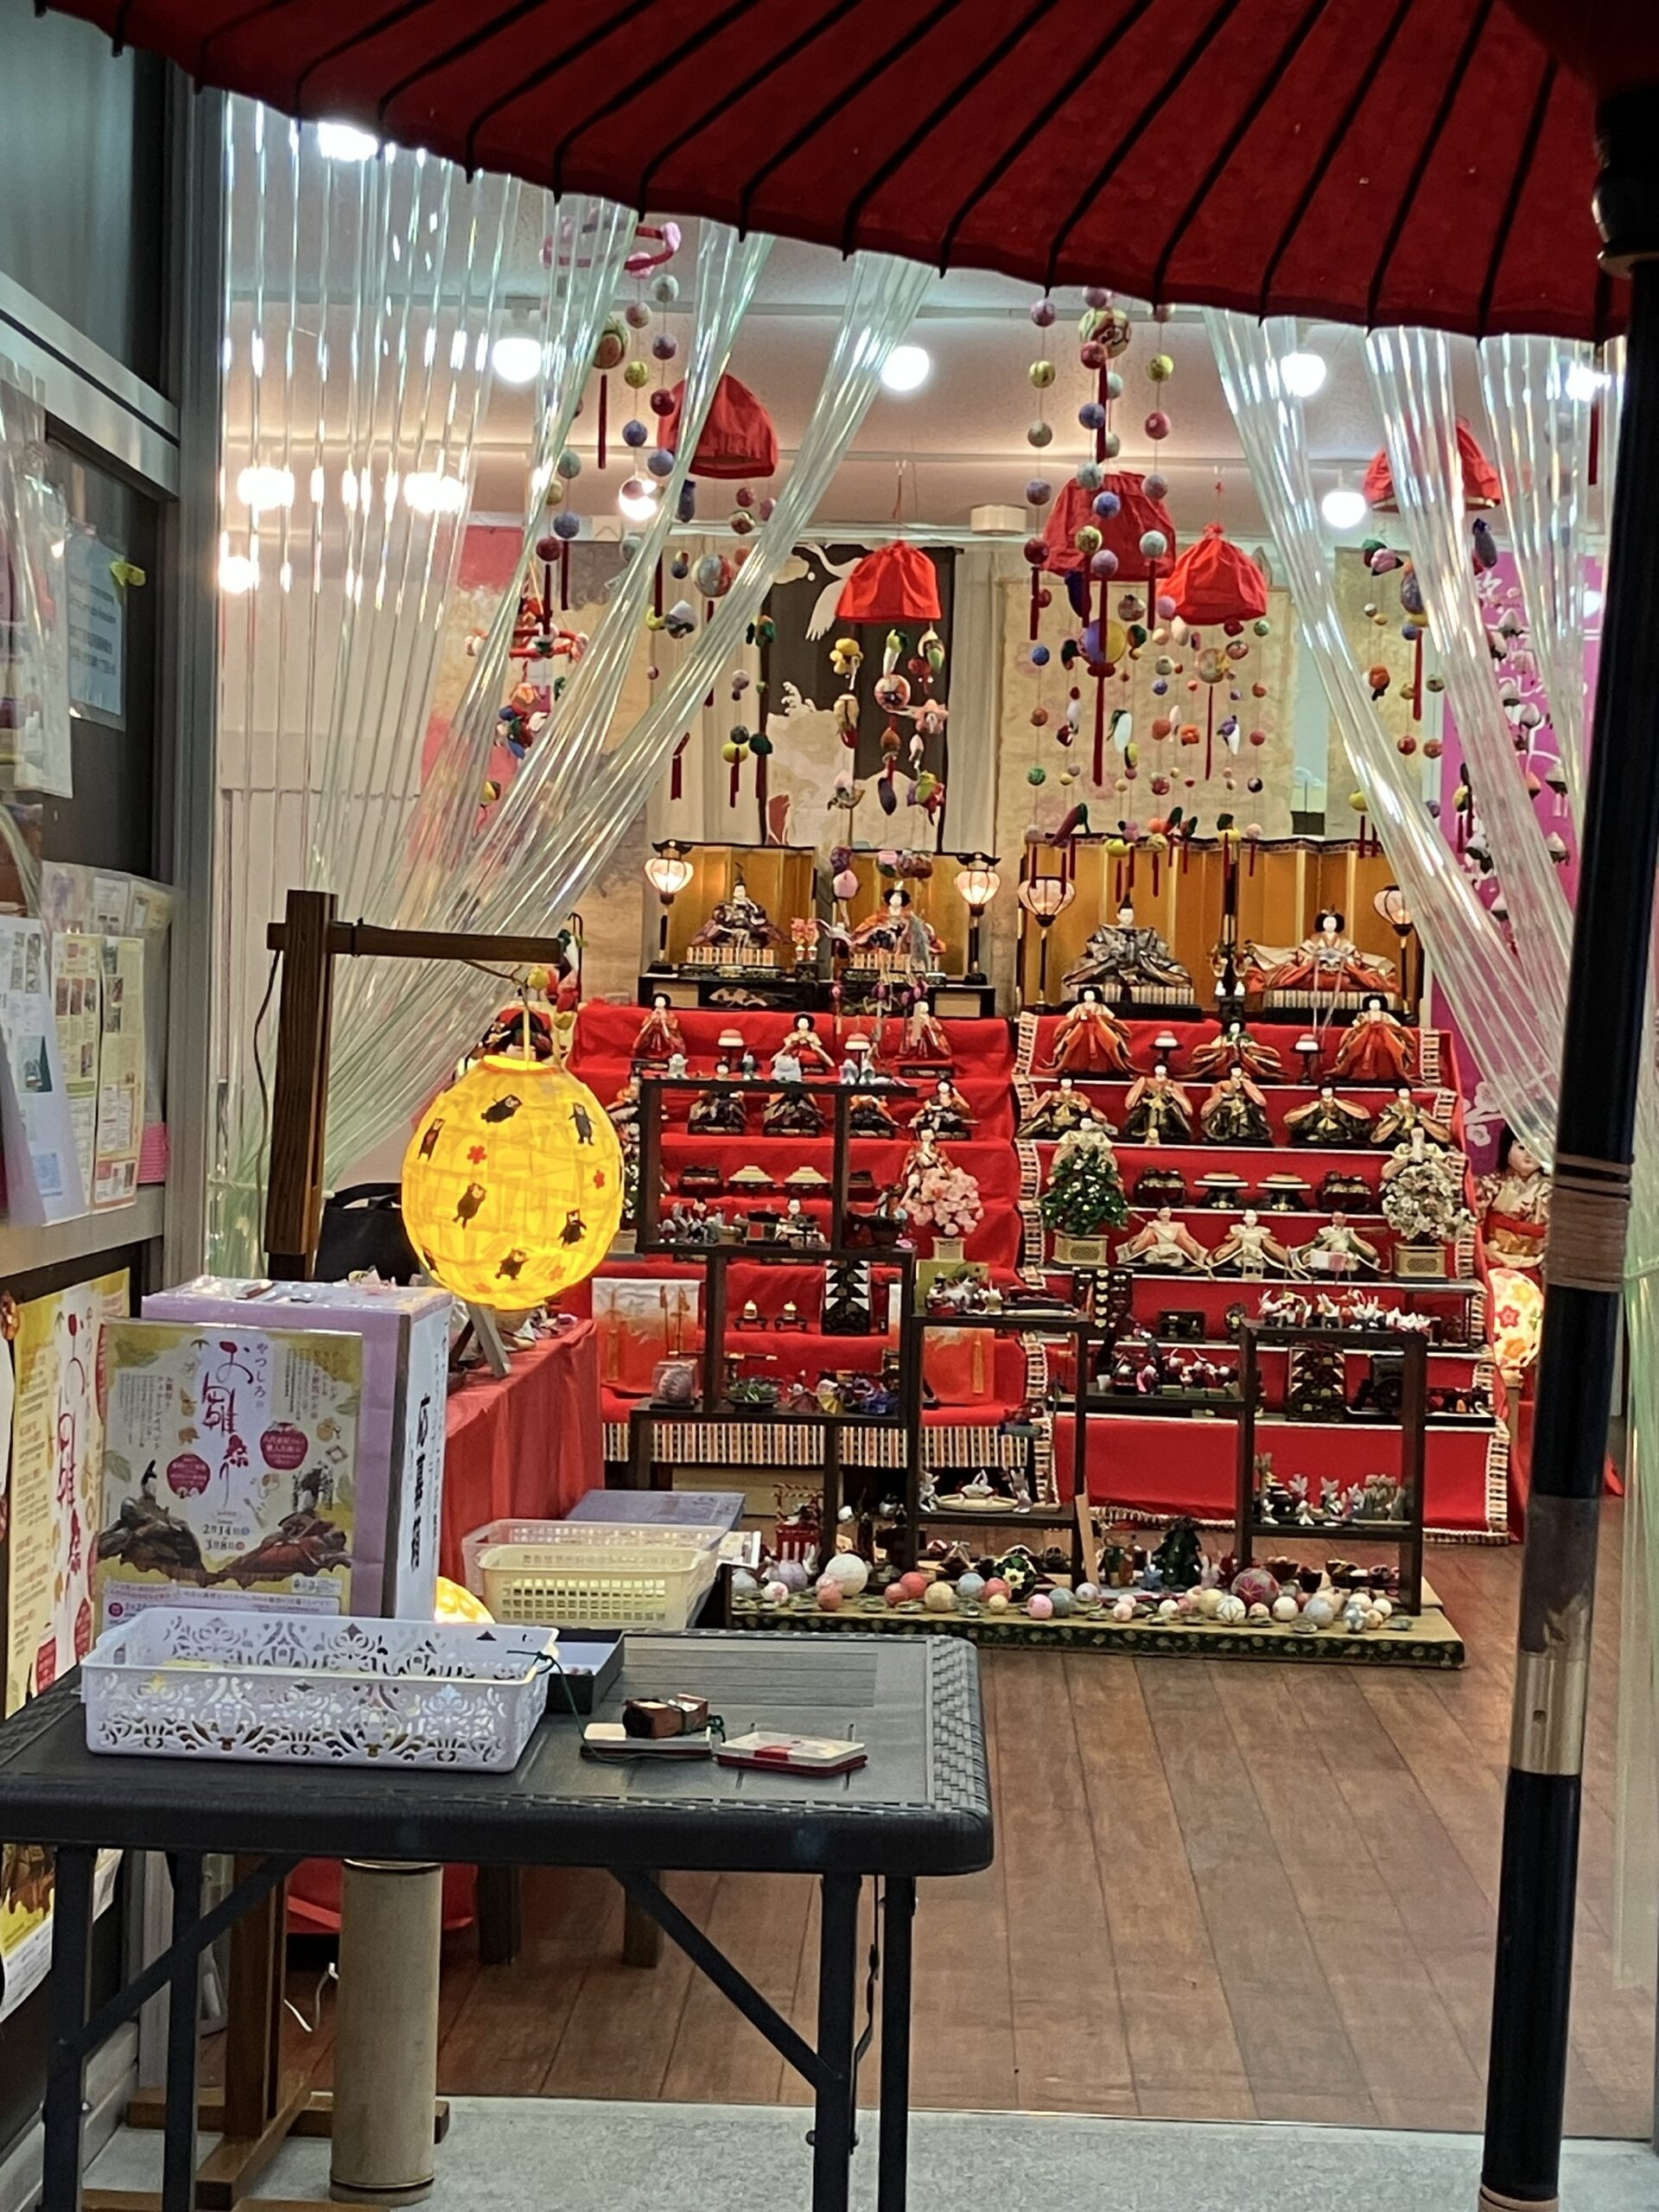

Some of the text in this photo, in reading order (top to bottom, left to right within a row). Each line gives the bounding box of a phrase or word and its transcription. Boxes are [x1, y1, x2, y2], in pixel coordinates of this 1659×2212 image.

[201, 1340, 254, 1507] お雛祭り
[254, 1343, 269, 1408] やつしろの
